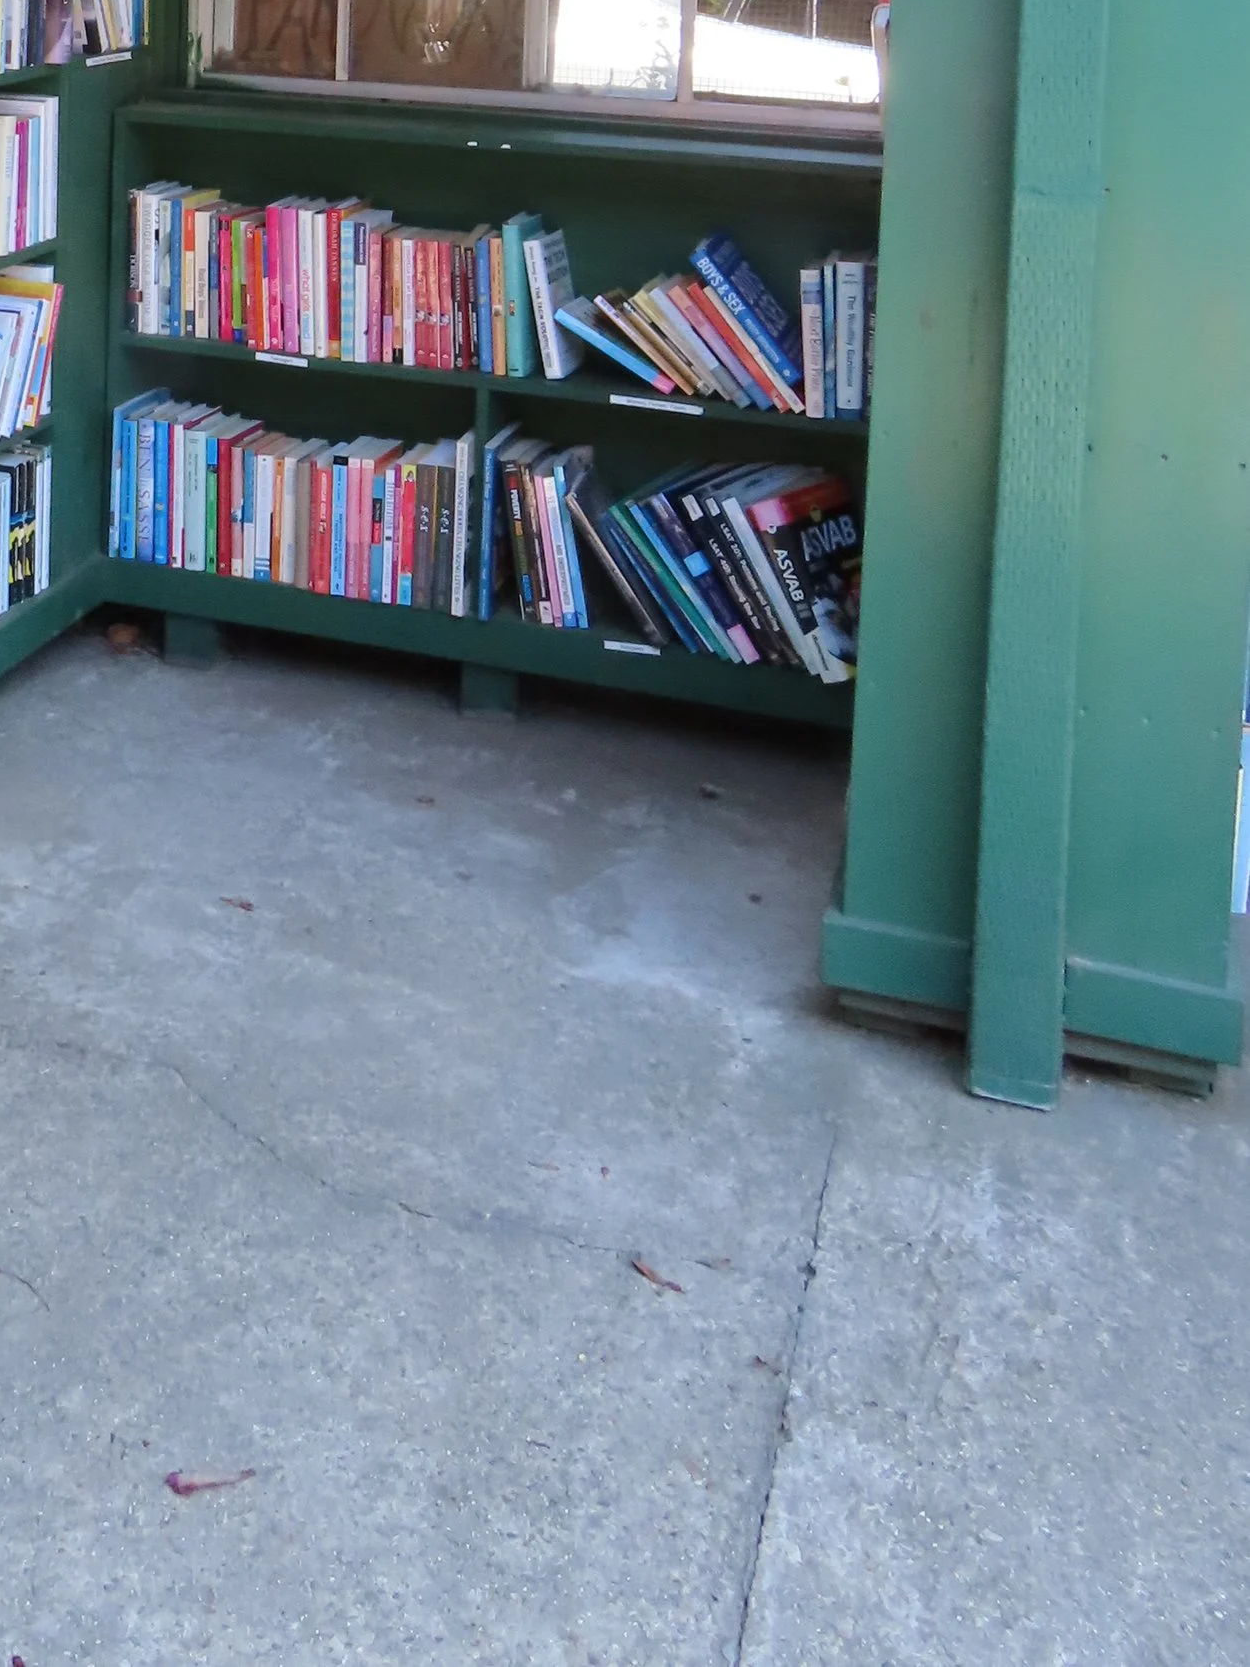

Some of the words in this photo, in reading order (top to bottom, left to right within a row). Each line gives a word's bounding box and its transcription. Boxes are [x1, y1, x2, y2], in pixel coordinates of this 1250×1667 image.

[143, 202, 152, 251] SWAGGER
[302, 269, 311, 292] what
[697, 257, 724, 287] BOYS
[717, 284, 728, 296] &
[723, 293, 747, 316] SEX
[847, 295, 856, 311] The
[139, 434, 151, 471] BEN
[510, 489, 520, 519] POVERTY
[708, 537, 722, 558] LSAT
[719, 522, 731, 543] LSAT
[800, 514, 857, 562] ASVAB
[773, 548, 805, 602] ASVAB
